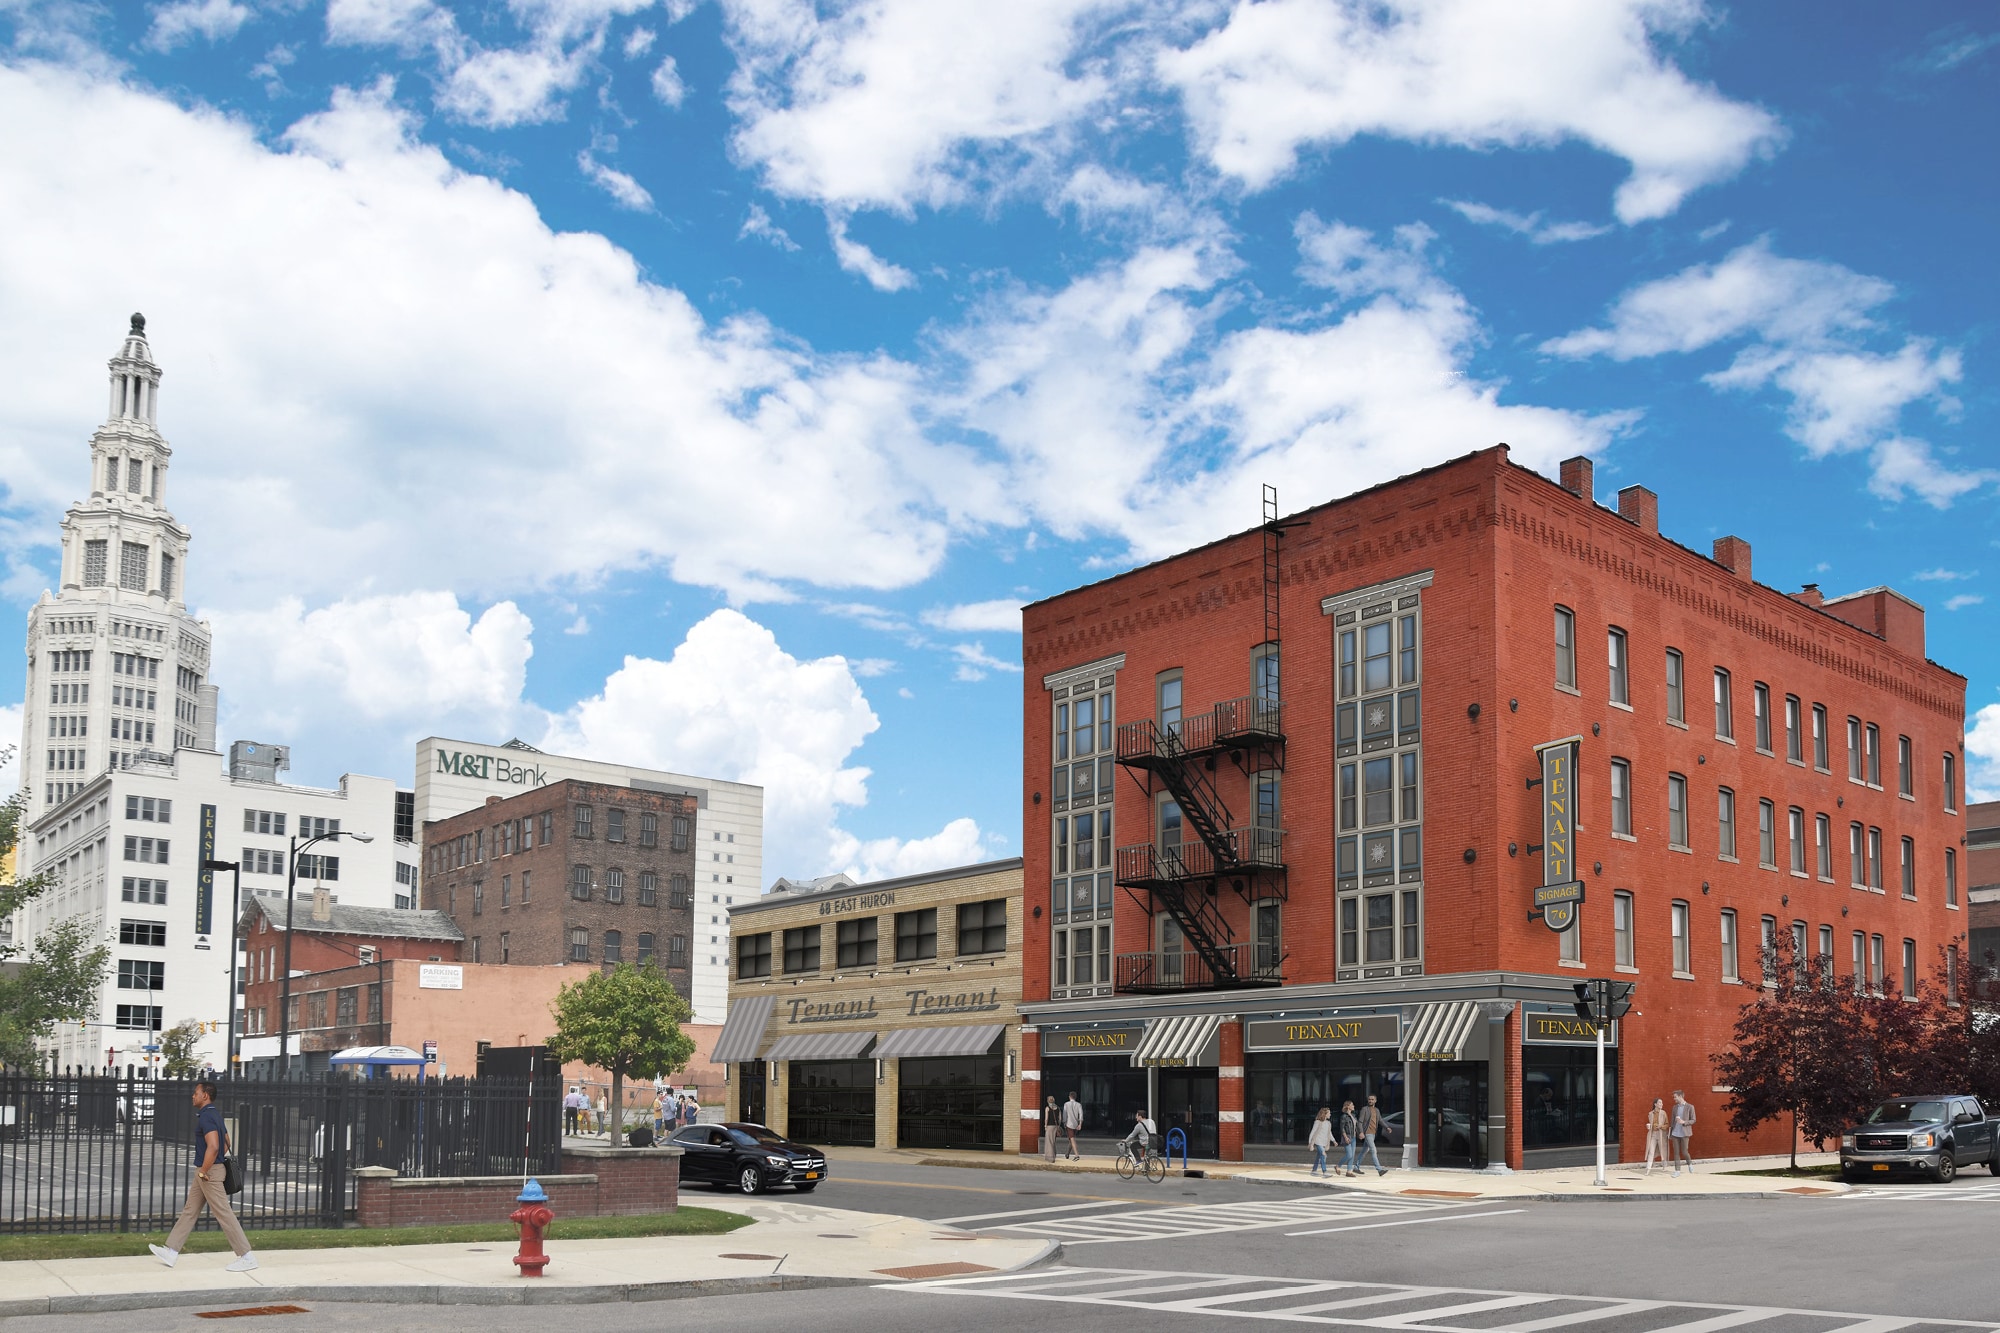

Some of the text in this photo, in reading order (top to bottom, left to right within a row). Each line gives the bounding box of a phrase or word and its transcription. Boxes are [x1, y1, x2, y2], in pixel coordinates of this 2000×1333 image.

[436, 749, 547, 786] M&T Bank
[1550, 757, 1567, 876] TENANT
[202, 808, 214, 884] LEASIG
[1538, 885, 1578, 901] SIGNAGE
[819, 893, 895, 914] 68 EAST HURON
[1550, 909, 1567, 920] 76
[423, 968, 459, 977] PARKING
[786, 995, 876, 1024] Tenant
[906, 987, 998, 1016] Tenant
[1067, 1033, 1127, 1048] TENANT
[1285, 1022, 1363, 1041] TENANT
[1159, 1058, 1185, 1067] HURON
[1430, 1051, 1454, 1059] Huron
